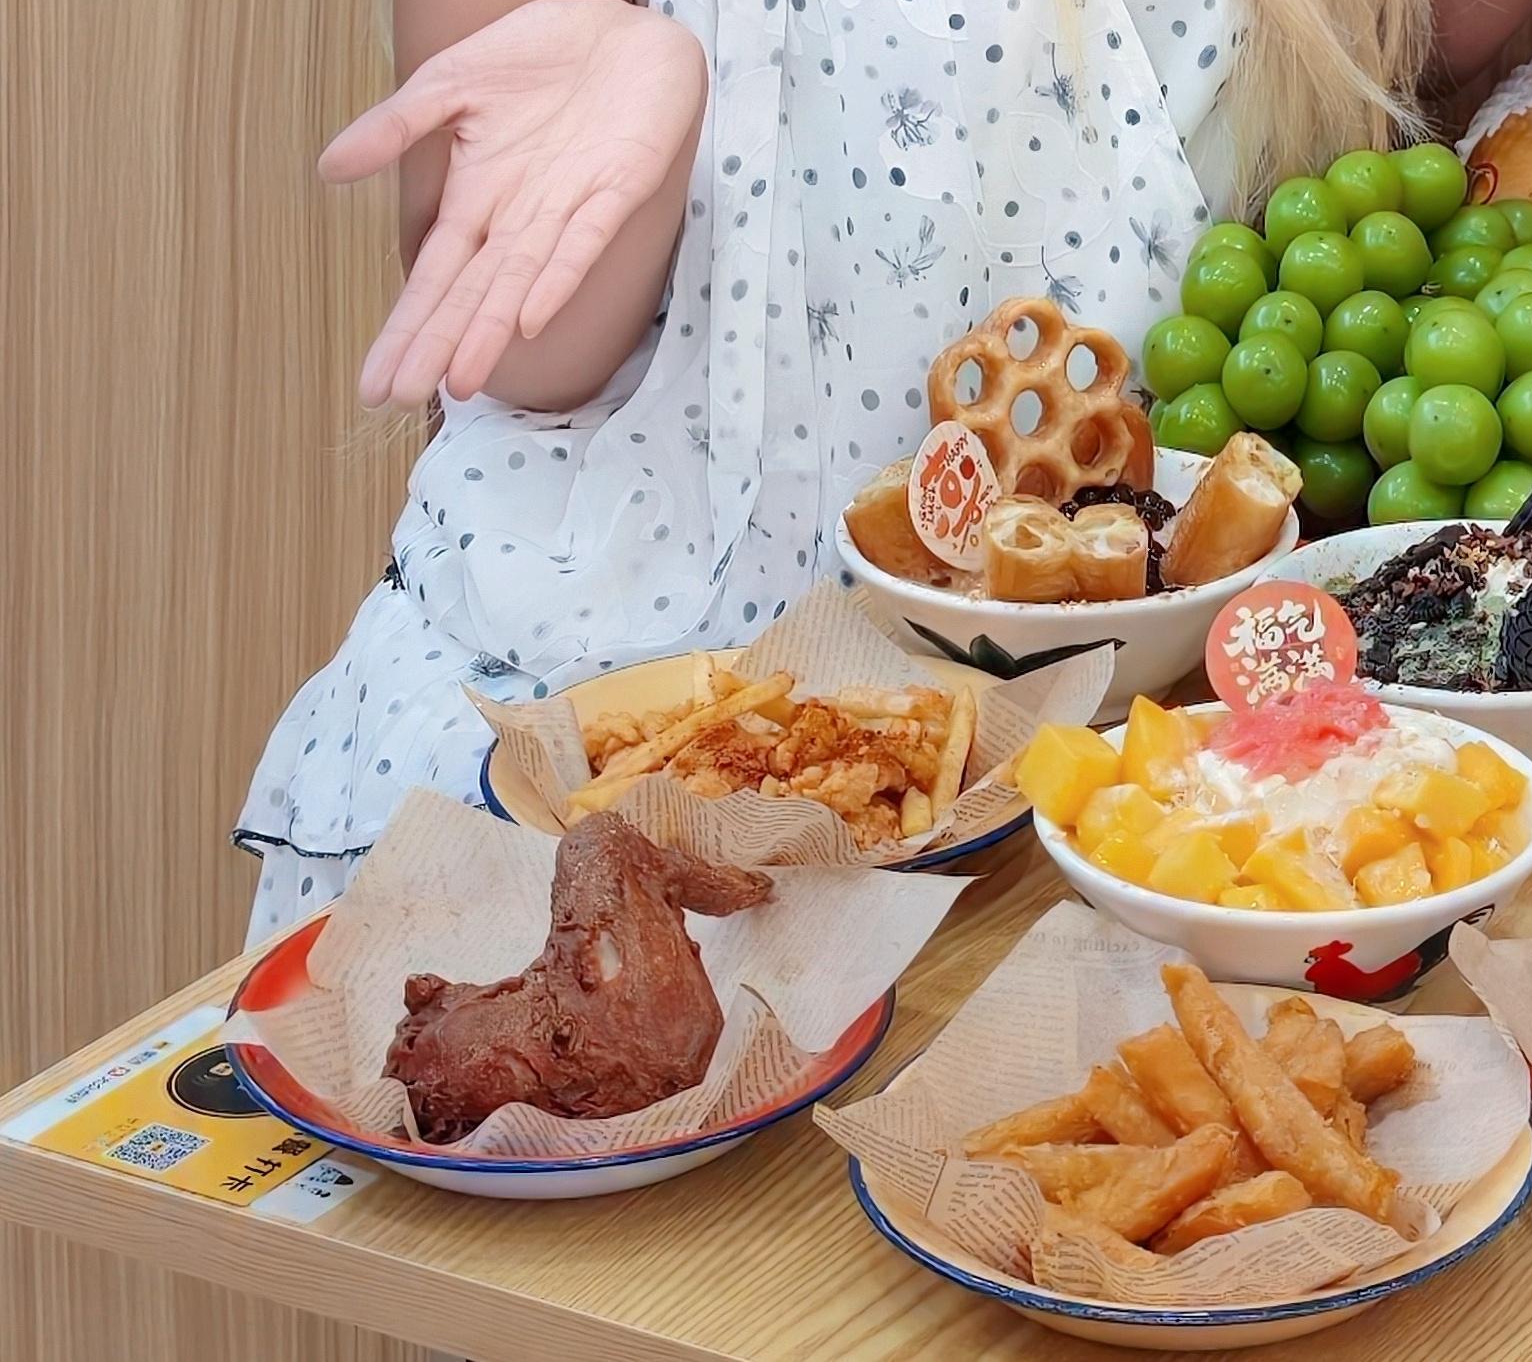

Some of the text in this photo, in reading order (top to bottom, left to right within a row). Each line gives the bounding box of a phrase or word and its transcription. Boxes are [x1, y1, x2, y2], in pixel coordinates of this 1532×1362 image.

[1221, 598, 1327, 658] 福气
[220, 1132, 312, 1192] 餐打卡
